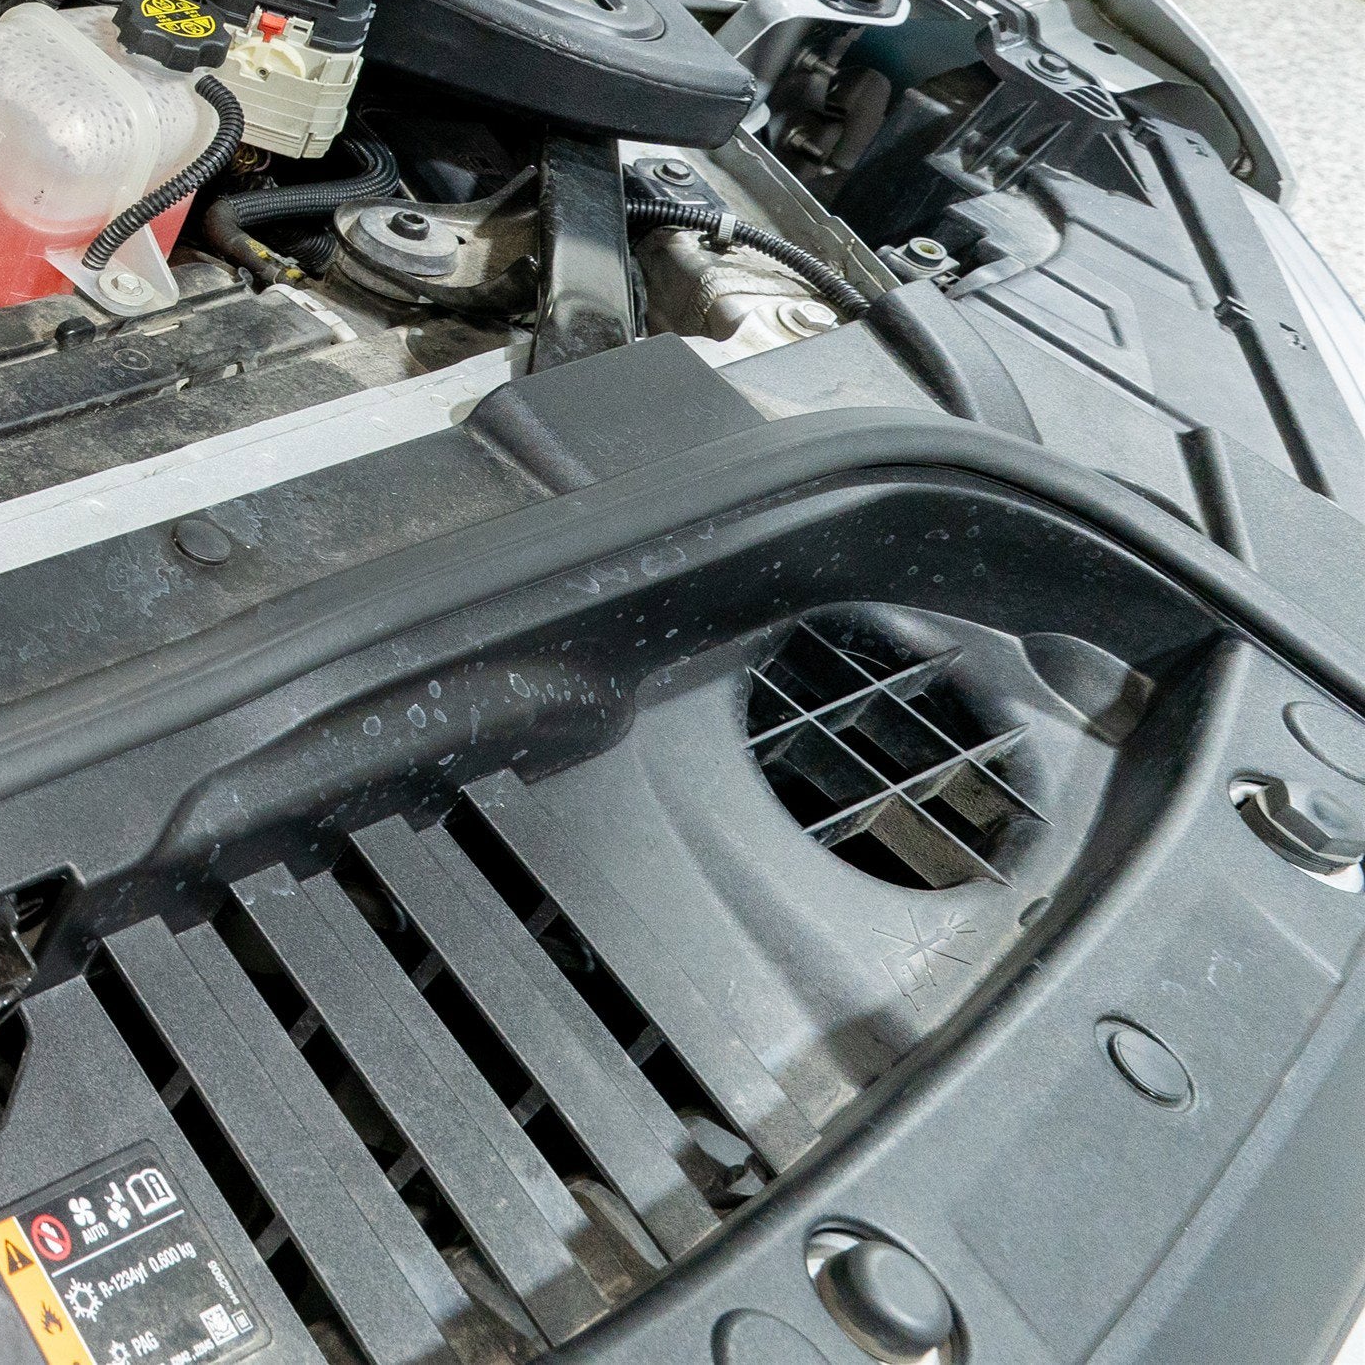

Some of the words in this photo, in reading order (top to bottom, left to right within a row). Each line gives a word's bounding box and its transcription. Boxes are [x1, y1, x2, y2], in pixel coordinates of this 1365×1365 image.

[81, 1221, 109, 1245] AUTO
[97, 1262, 149, 1300] R-1234yf
[148, 1246, 180, 1274] 0.600
[177, 1241, 197, 1259] kg
[130, 1331, 160, 1357] PAG
